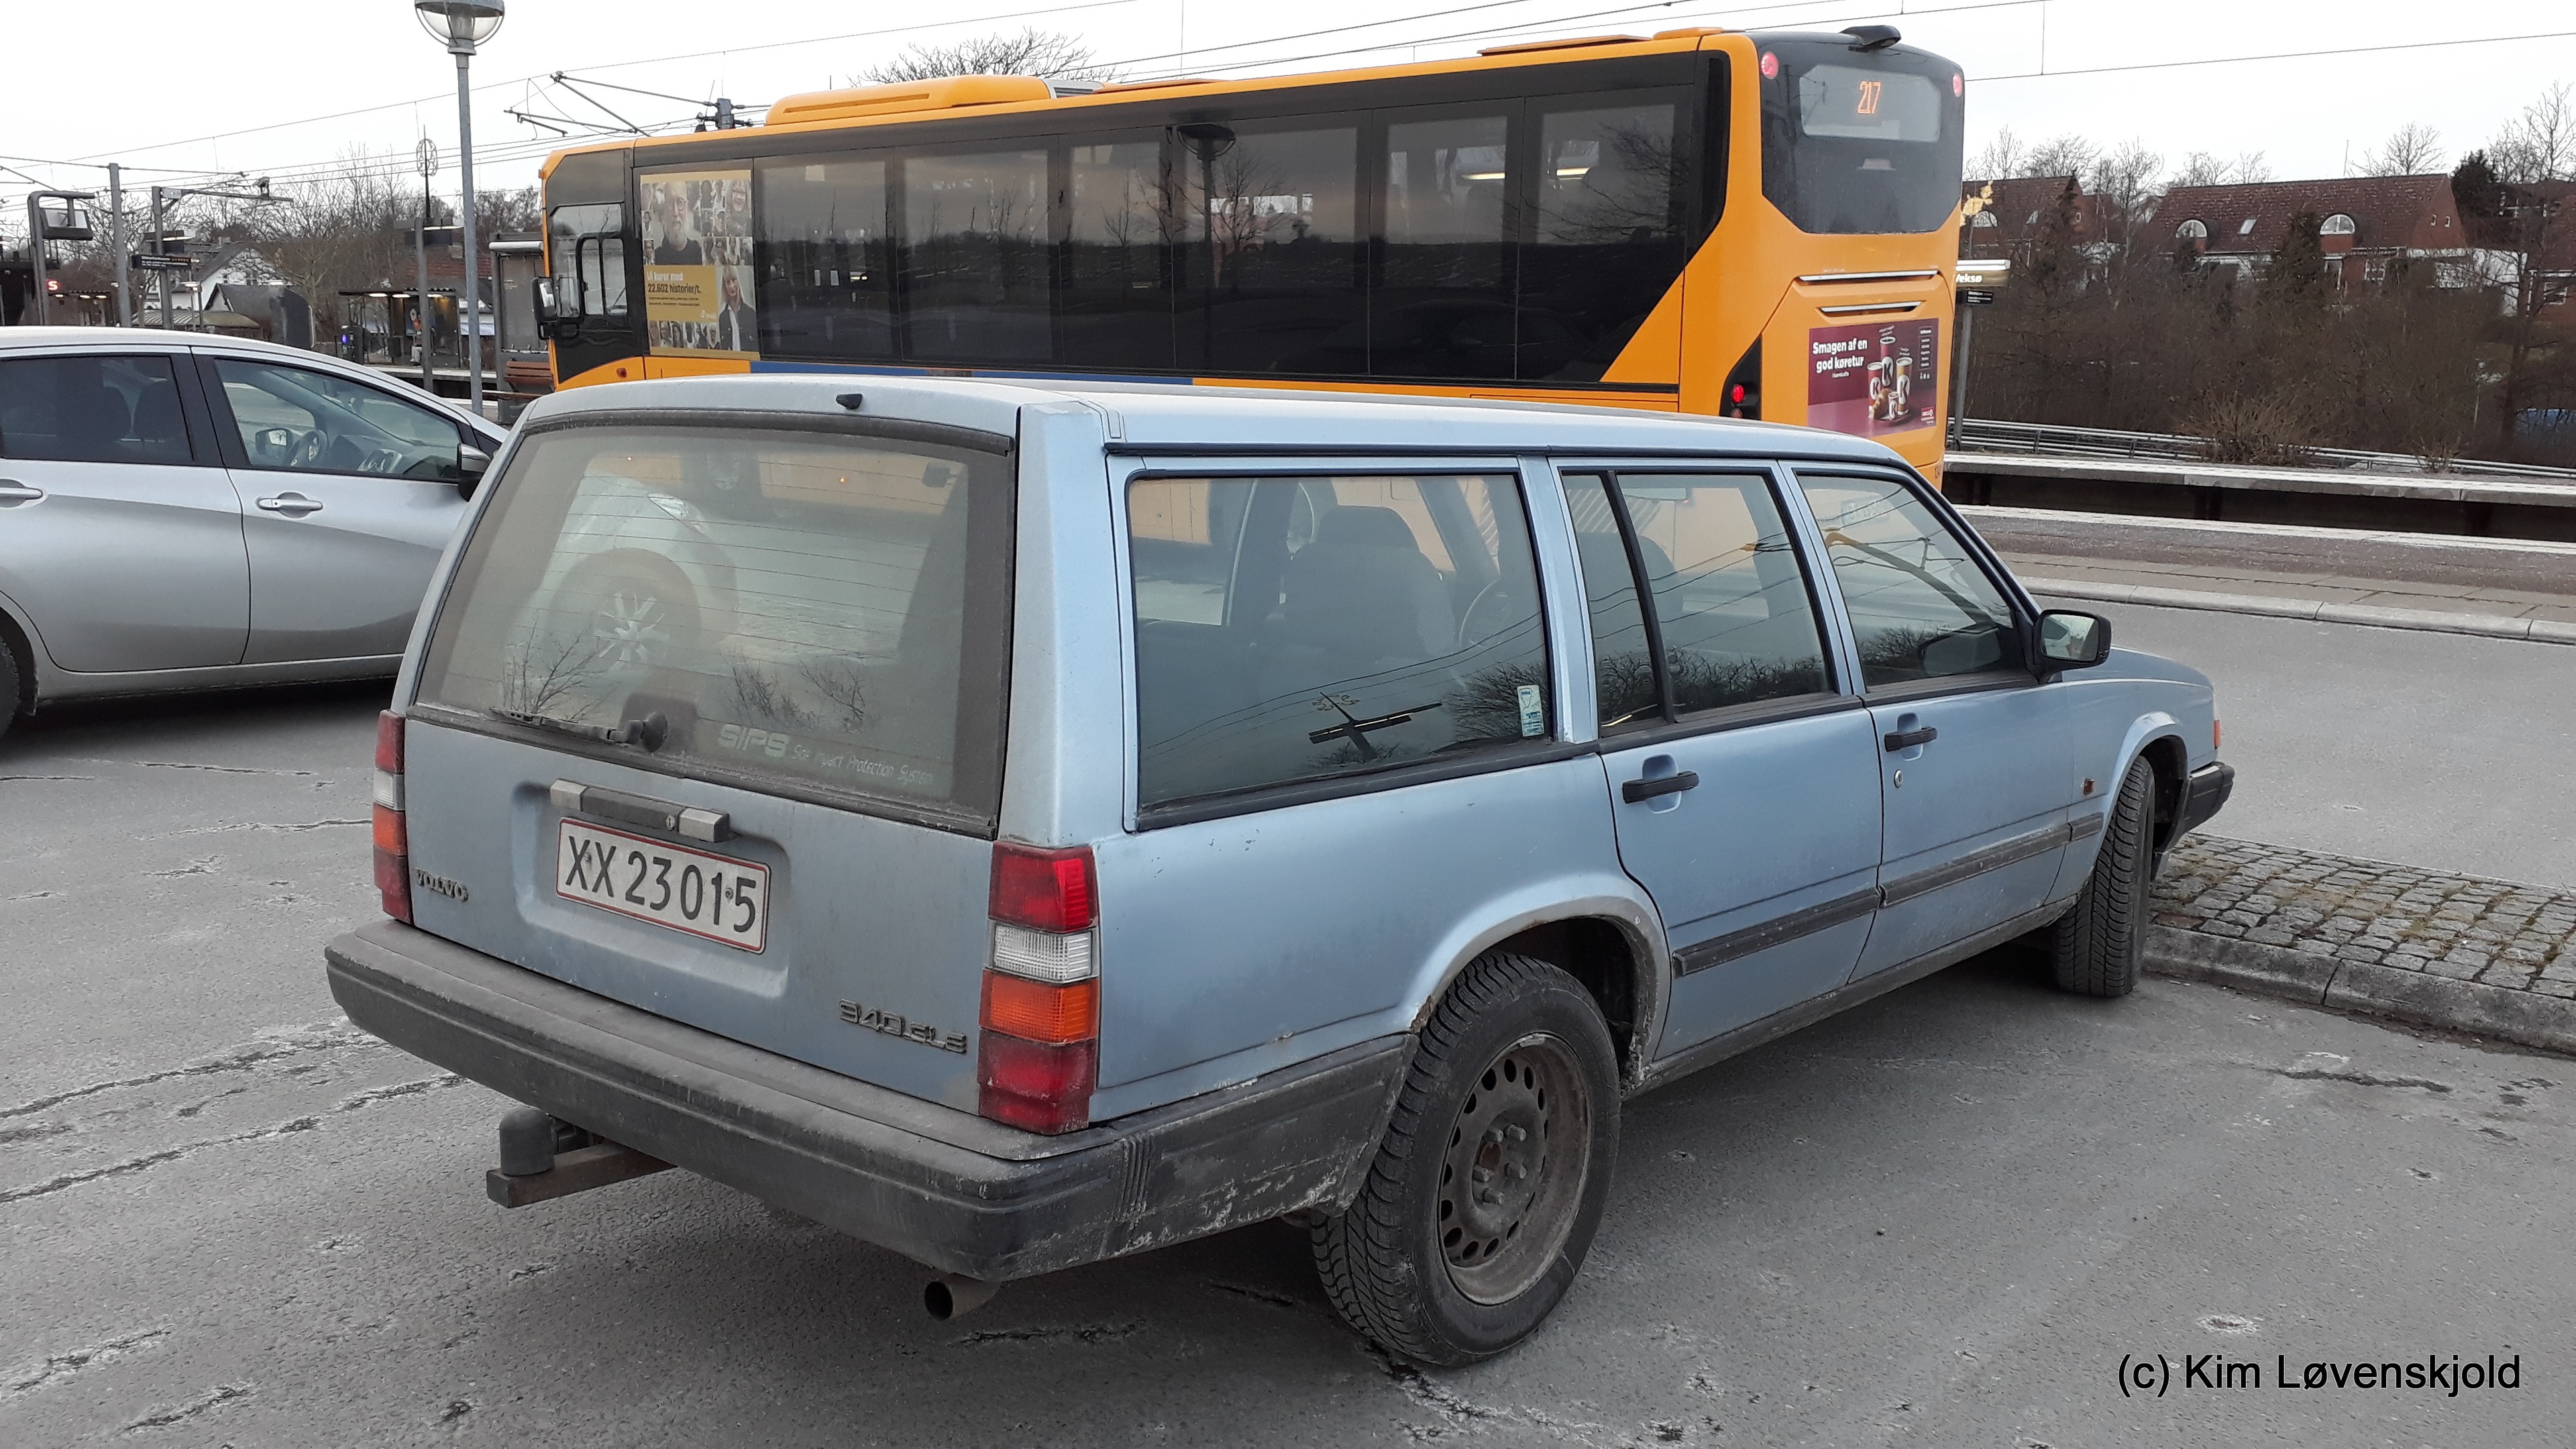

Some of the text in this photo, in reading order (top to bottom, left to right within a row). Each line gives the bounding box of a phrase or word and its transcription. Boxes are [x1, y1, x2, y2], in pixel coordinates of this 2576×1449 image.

[1858, 80, 1881, 114] 217
[48, 280, 58, 290] S
[1813, 337, 1868, 355] Smagen af en
[1816, 356, 1864, 374] god køretur
[1884, 363, 1892, 381] K
[719, 724, 789, 757] SIPS
[415, 867, 469, 903] VOLVO
